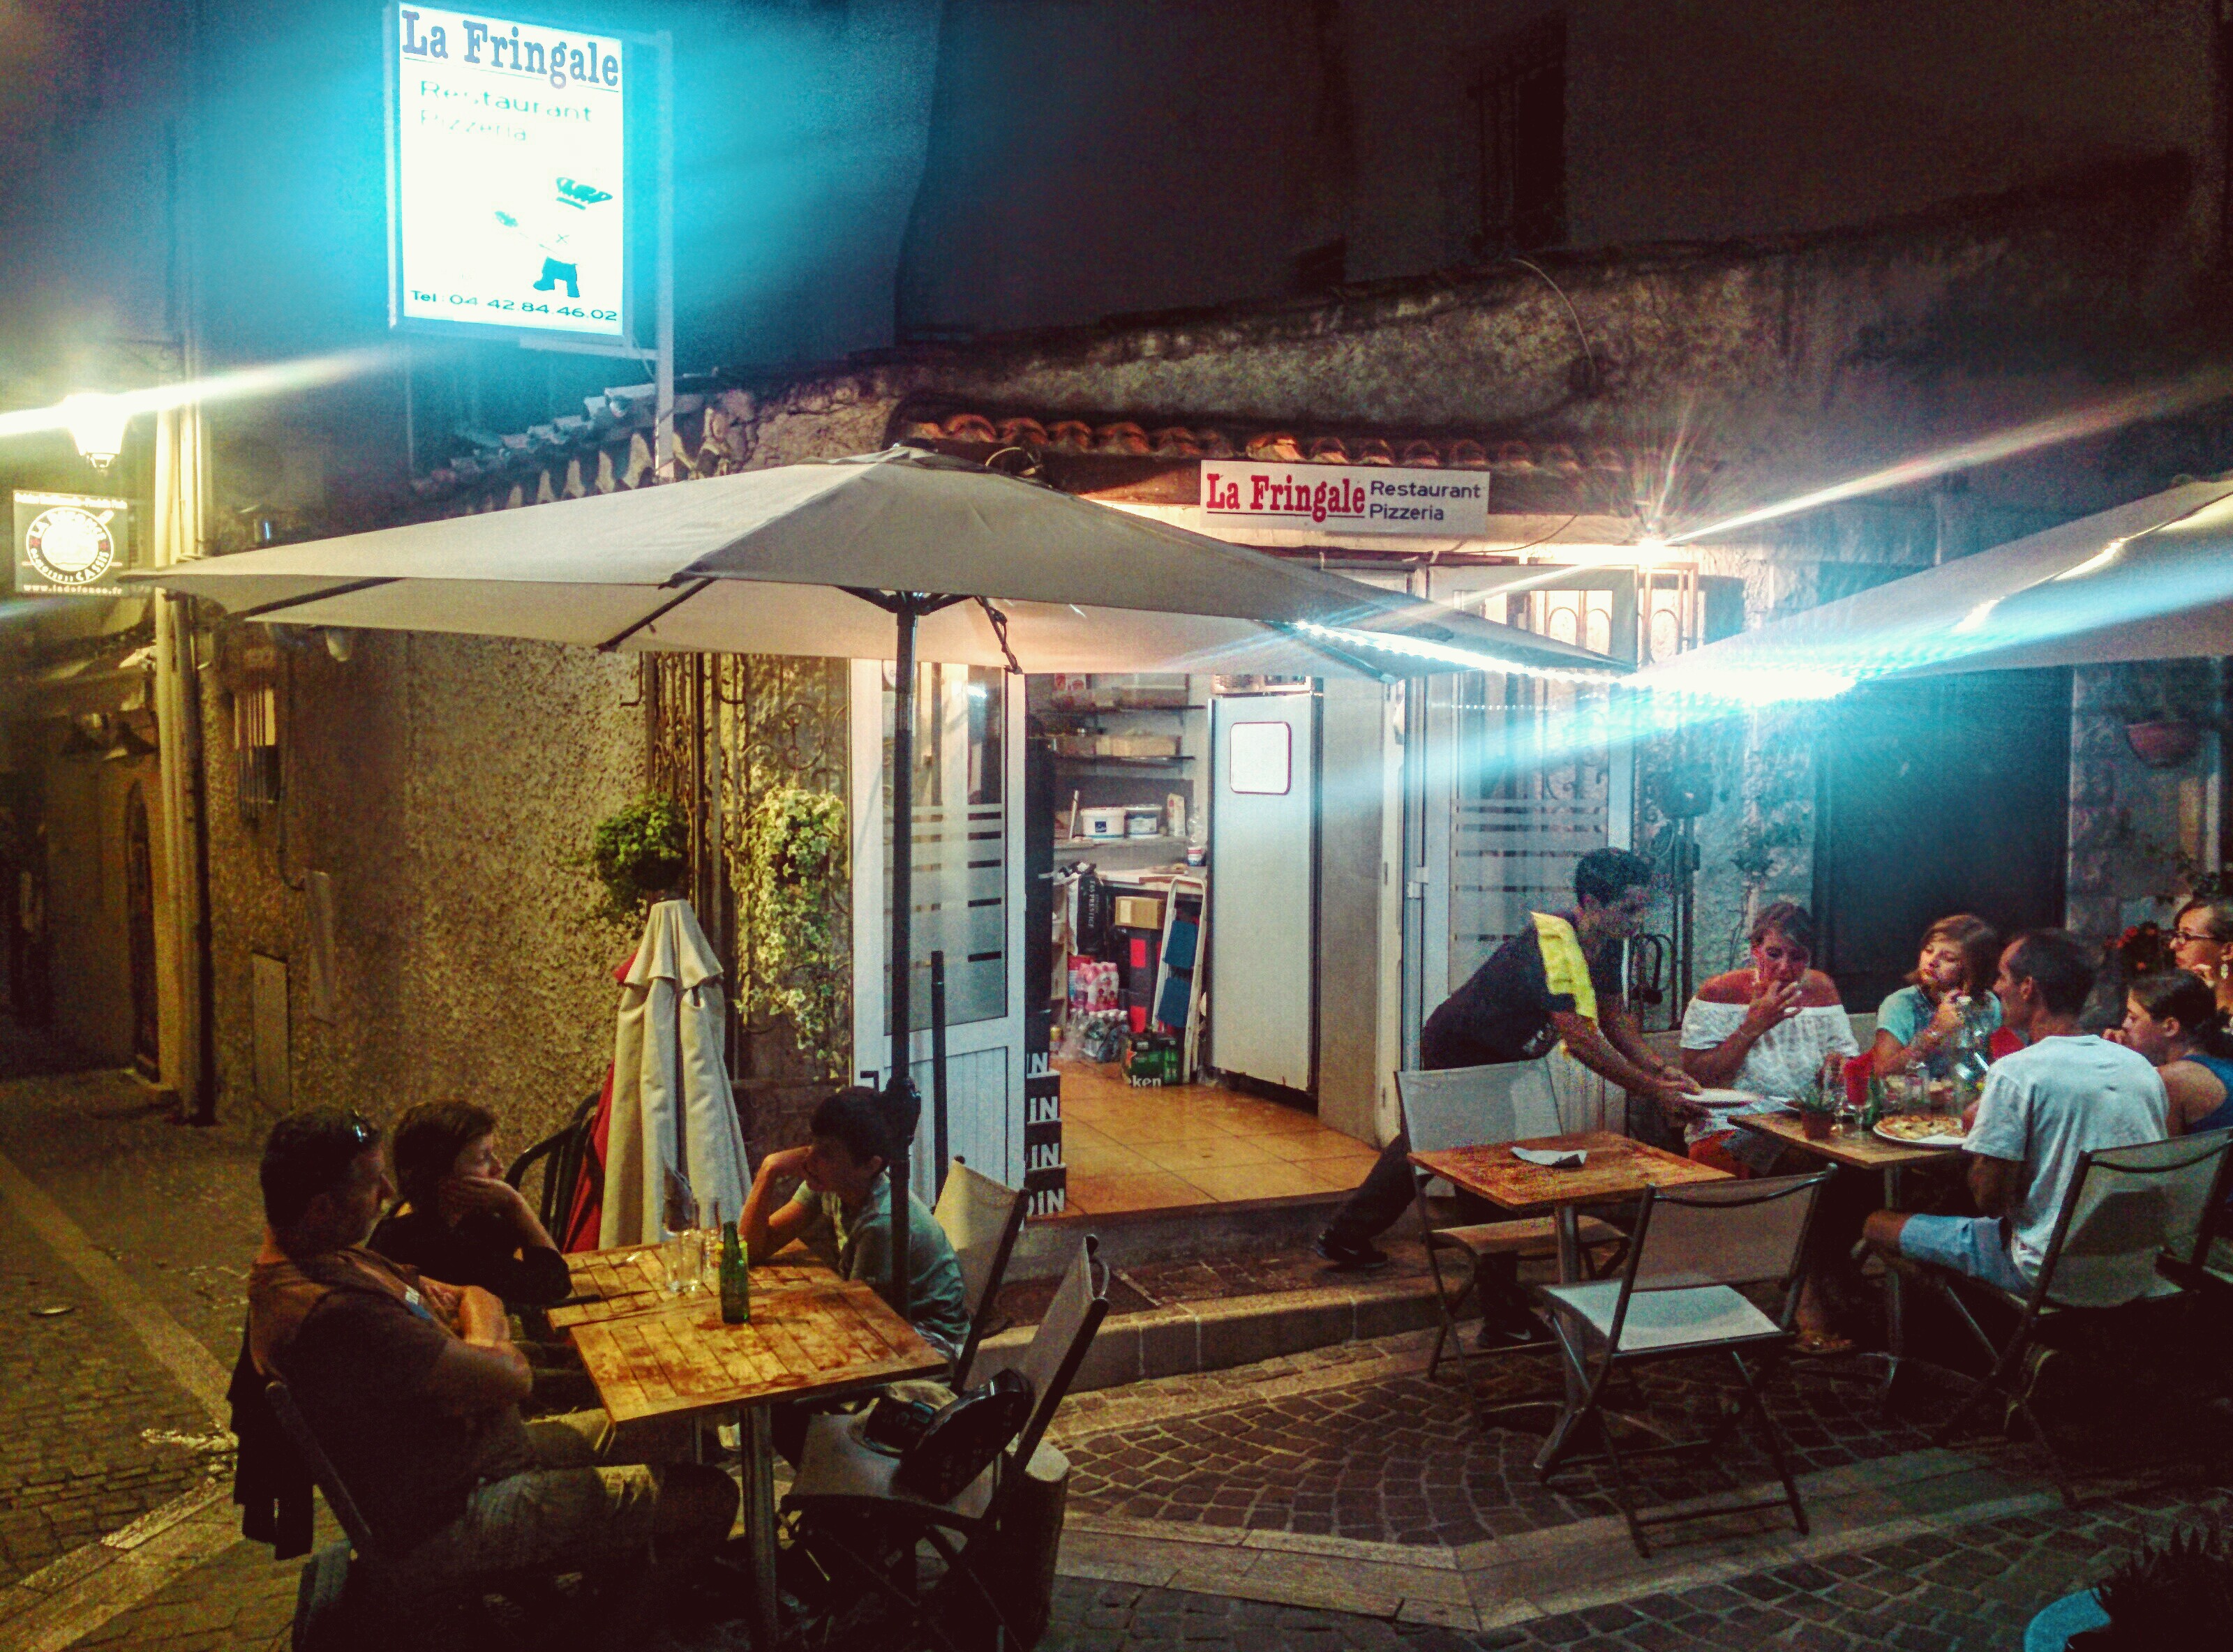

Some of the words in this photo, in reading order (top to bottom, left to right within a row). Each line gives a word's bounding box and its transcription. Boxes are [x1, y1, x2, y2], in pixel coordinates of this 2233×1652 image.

[401, 10, 449, 59] La
[463, 20, 618, 89] Fringale
[421, 80, 591, 122] Retaurant
[1206, 473, 1241, 510] La
[1250, 474, 1366, 523] Fringale
[1370, 480, 1481, 499] Restaurant
[1370, 503, 1444, 521] Pizzeria
[1129, 1075, 1161, 1088] ken
